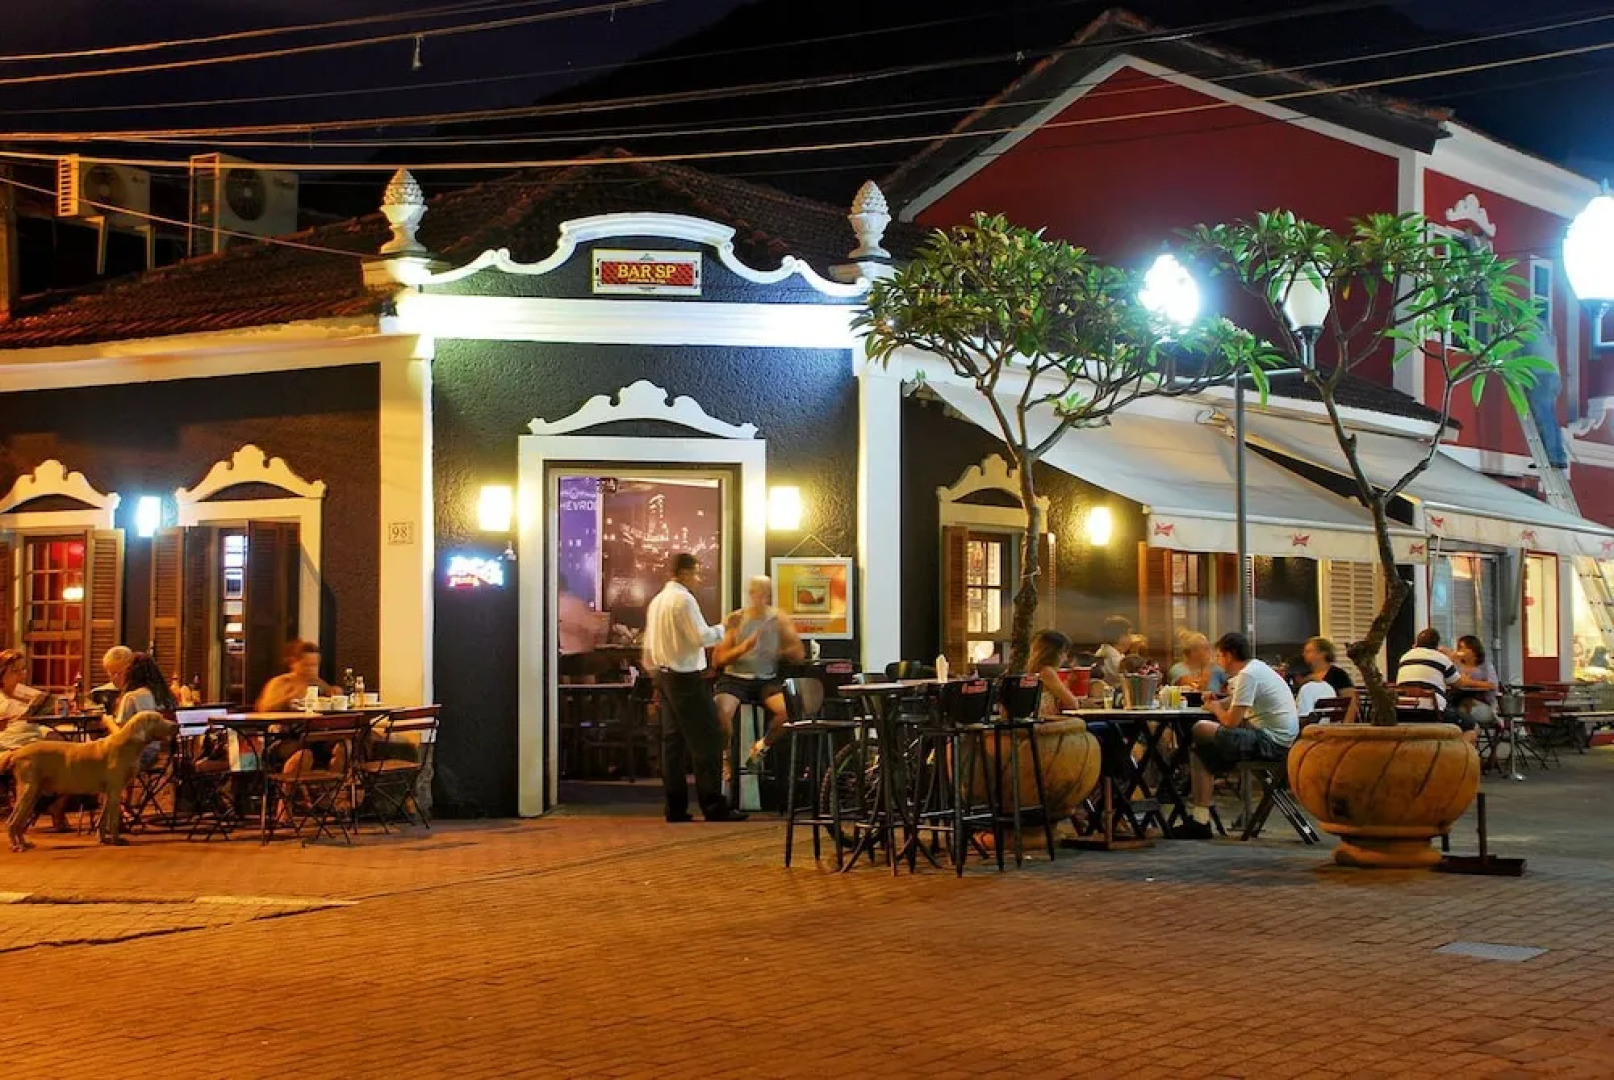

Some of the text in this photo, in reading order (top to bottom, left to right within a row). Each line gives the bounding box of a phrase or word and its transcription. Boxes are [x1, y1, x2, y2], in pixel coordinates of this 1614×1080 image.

[618, 264, 677, 279] BAR SP
[392, 525, 407, 540] 98
